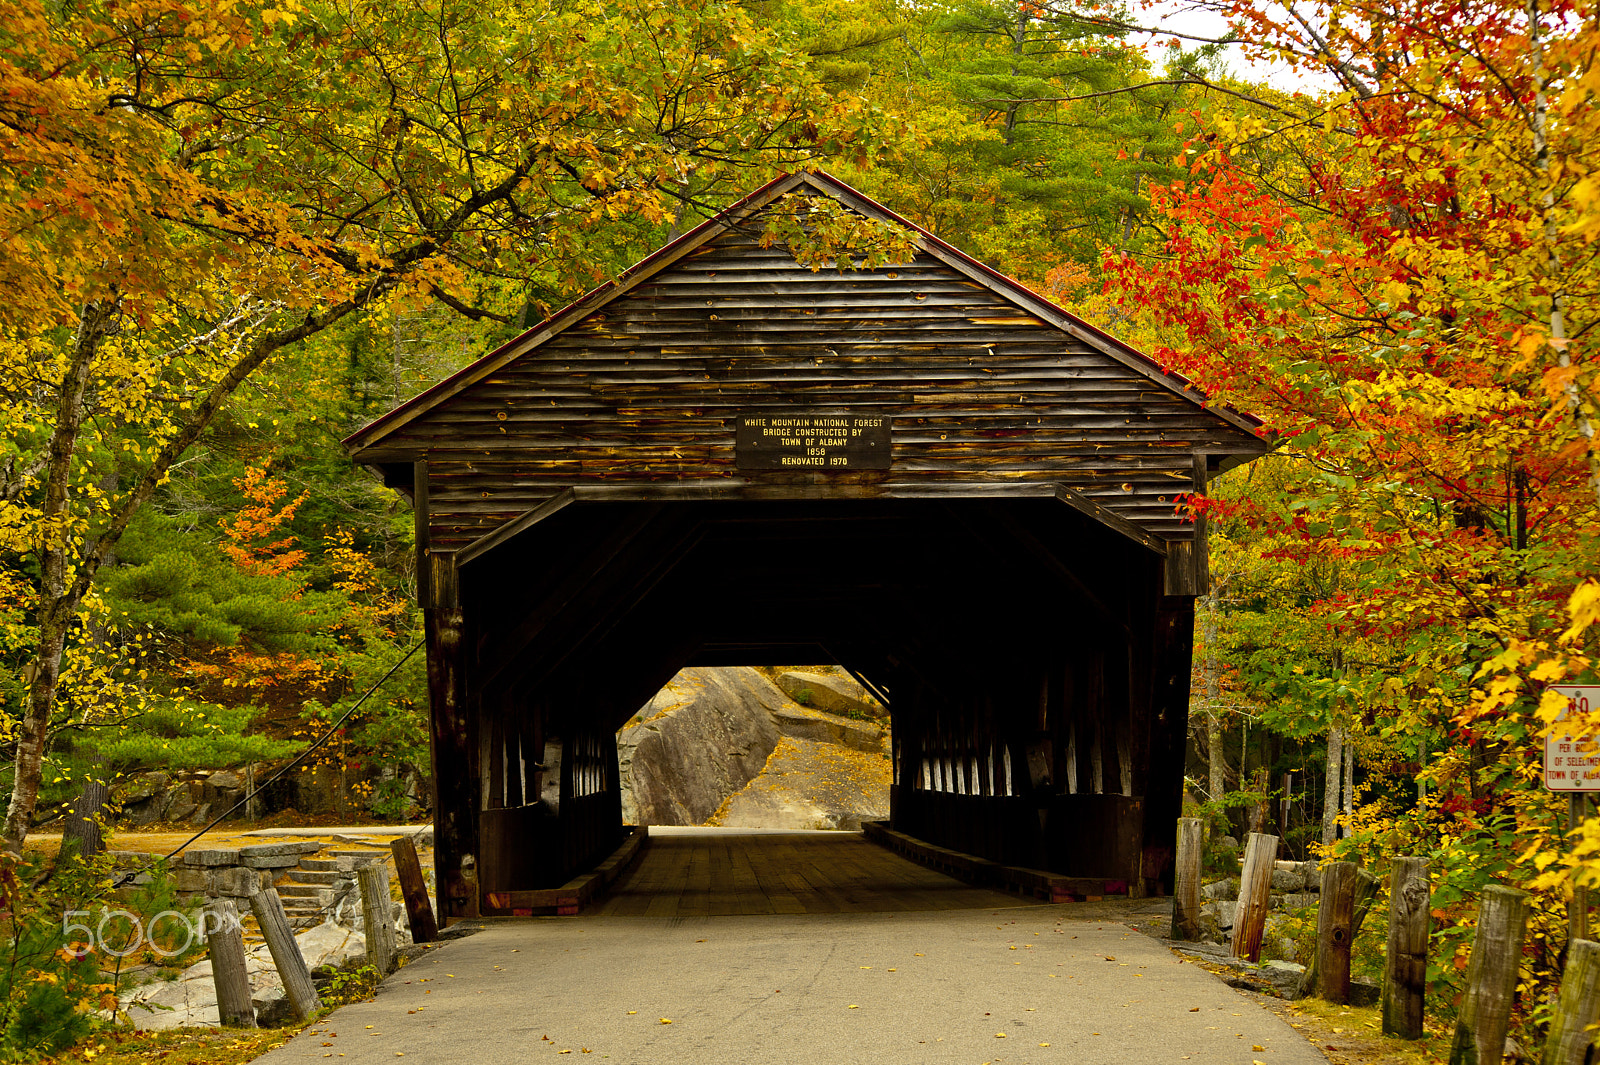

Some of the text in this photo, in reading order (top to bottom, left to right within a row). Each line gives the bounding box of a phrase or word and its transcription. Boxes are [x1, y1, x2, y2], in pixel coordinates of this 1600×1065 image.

[744, 418, 882, 426] WHITE MOUNTAIN NATIONAL FOREST
[763, 428, 862, 436] BRIDGE CONSTRUCTED BY
[782, 458, 848, 466] RENOVATED 1970
[1568, 697, 1588, 714] NO
[1559, 744, 1571, 752] PER
[1555, 757, 1563, 766] OF
[1548, 771, 1566, 780] TOWN
[1570, 771, 1578, 780] OF
